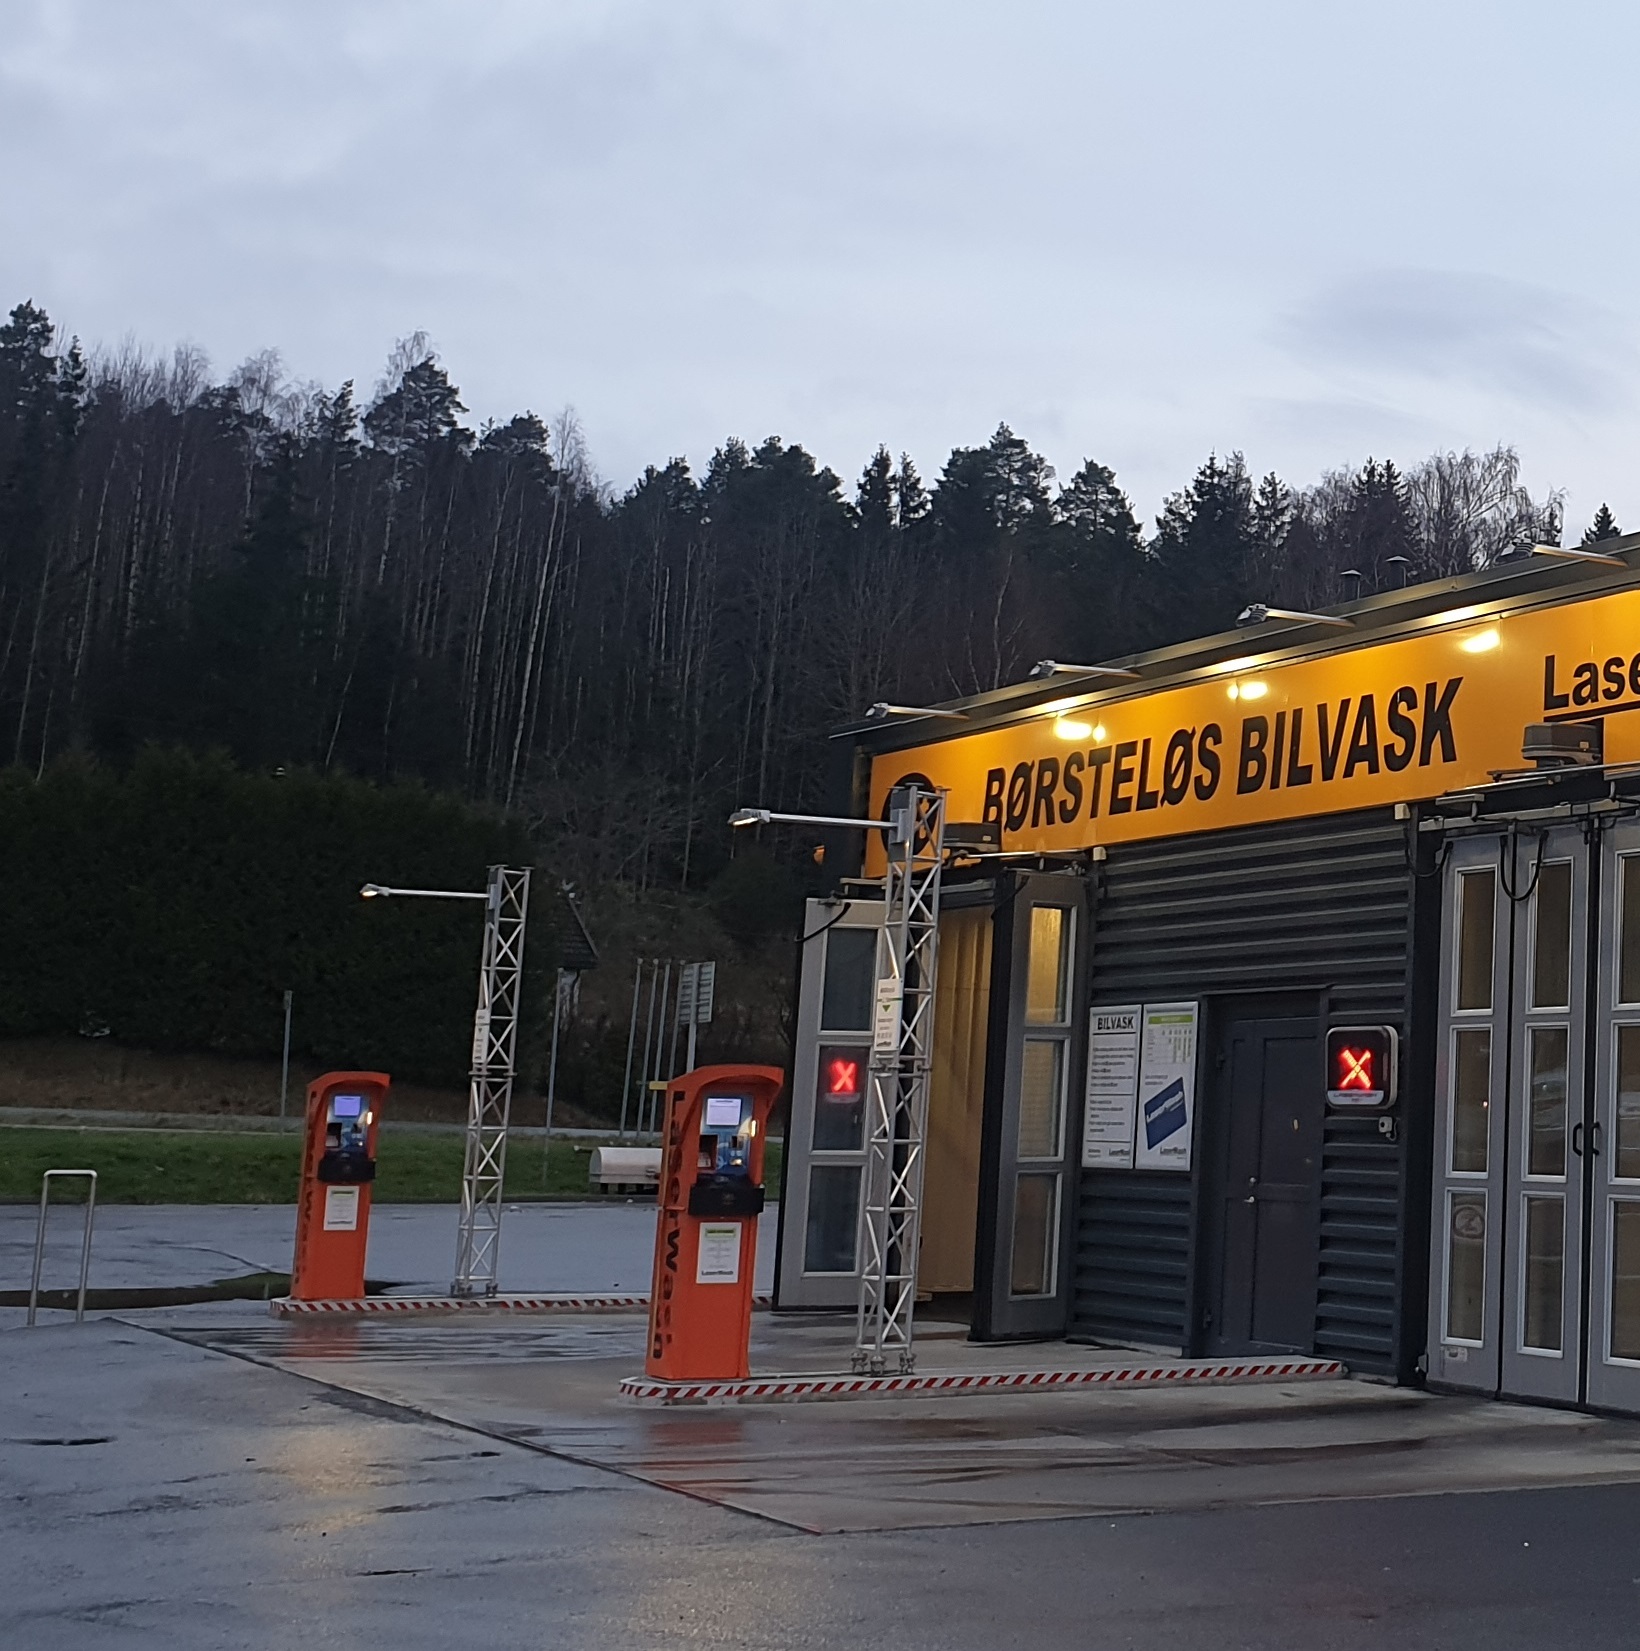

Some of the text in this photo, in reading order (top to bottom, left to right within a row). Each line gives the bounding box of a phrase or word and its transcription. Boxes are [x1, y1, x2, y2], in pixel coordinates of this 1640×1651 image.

[982, 724, 1223, 833] BØRSTELØS
[1237, 677, 1464, 796] BILVASK
[1097, 1016, 1134, 1030] BILVASK
